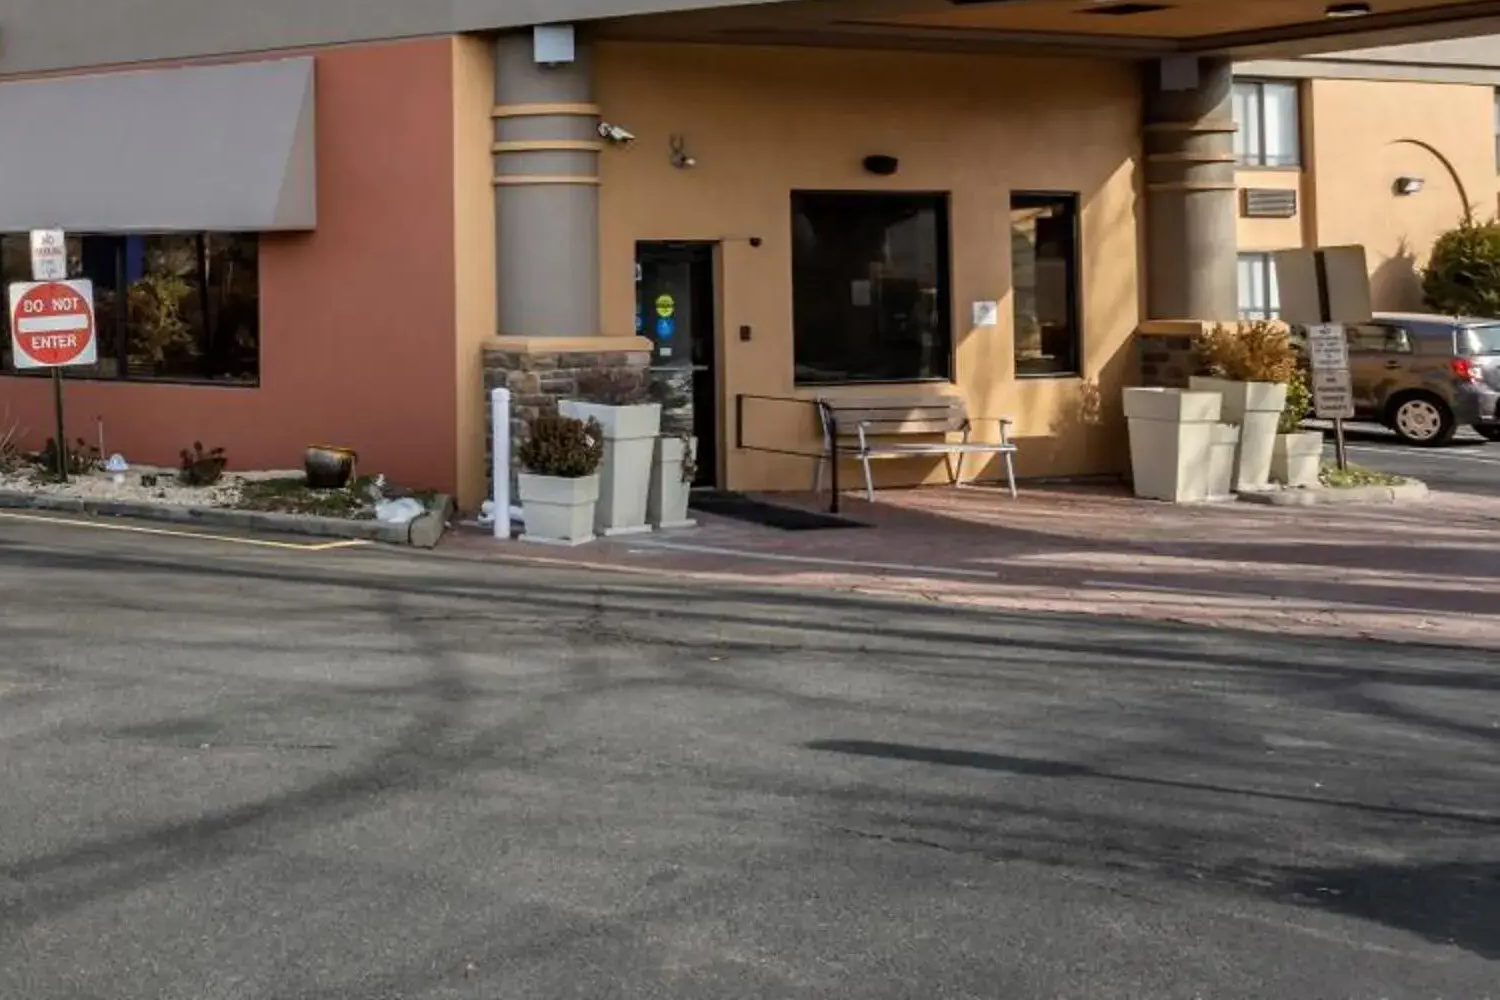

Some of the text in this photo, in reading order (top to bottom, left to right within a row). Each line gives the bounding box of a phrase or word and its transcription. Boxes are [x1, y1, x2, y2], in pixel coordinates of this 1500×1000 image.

[23, 297, 79, 313] DO NOT
[31, 334, 77, 349] ENTER
